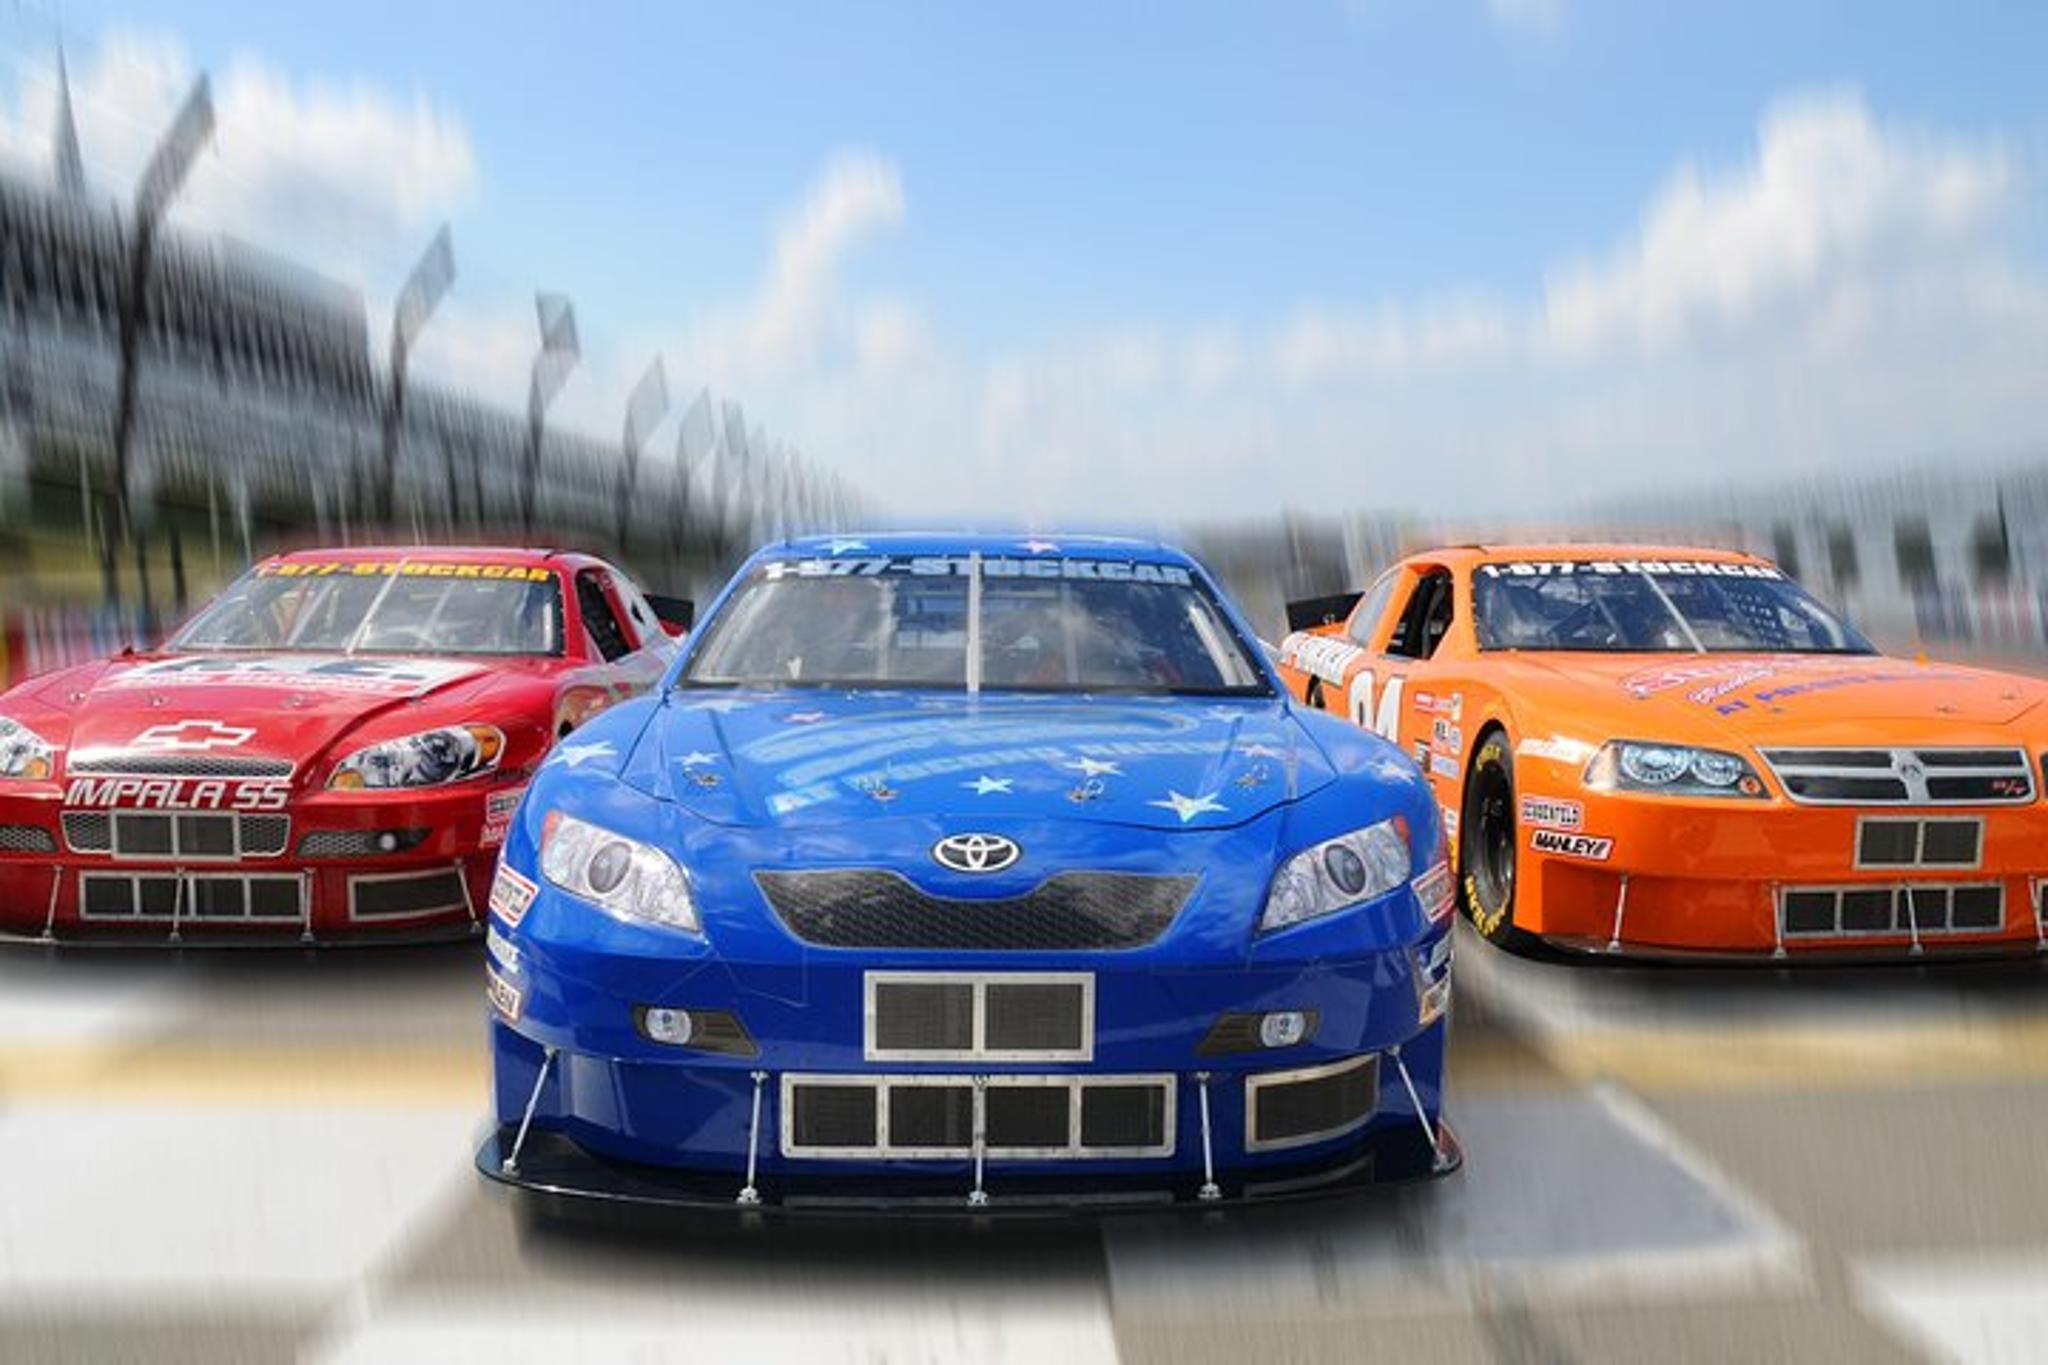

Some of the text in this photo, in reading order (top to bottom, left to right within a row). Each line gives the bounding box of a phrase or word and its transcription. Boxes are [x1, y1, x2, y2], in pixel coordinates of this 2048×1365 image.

[764, 558, 1194, 586] 1-877-STOCKCAR
[1481, 560, 1784, 580] 1-877-STOCKCAR
[64, 778, 292, 809] IMPALA SS
[1535, 832, 1598, 855] MANLEY
